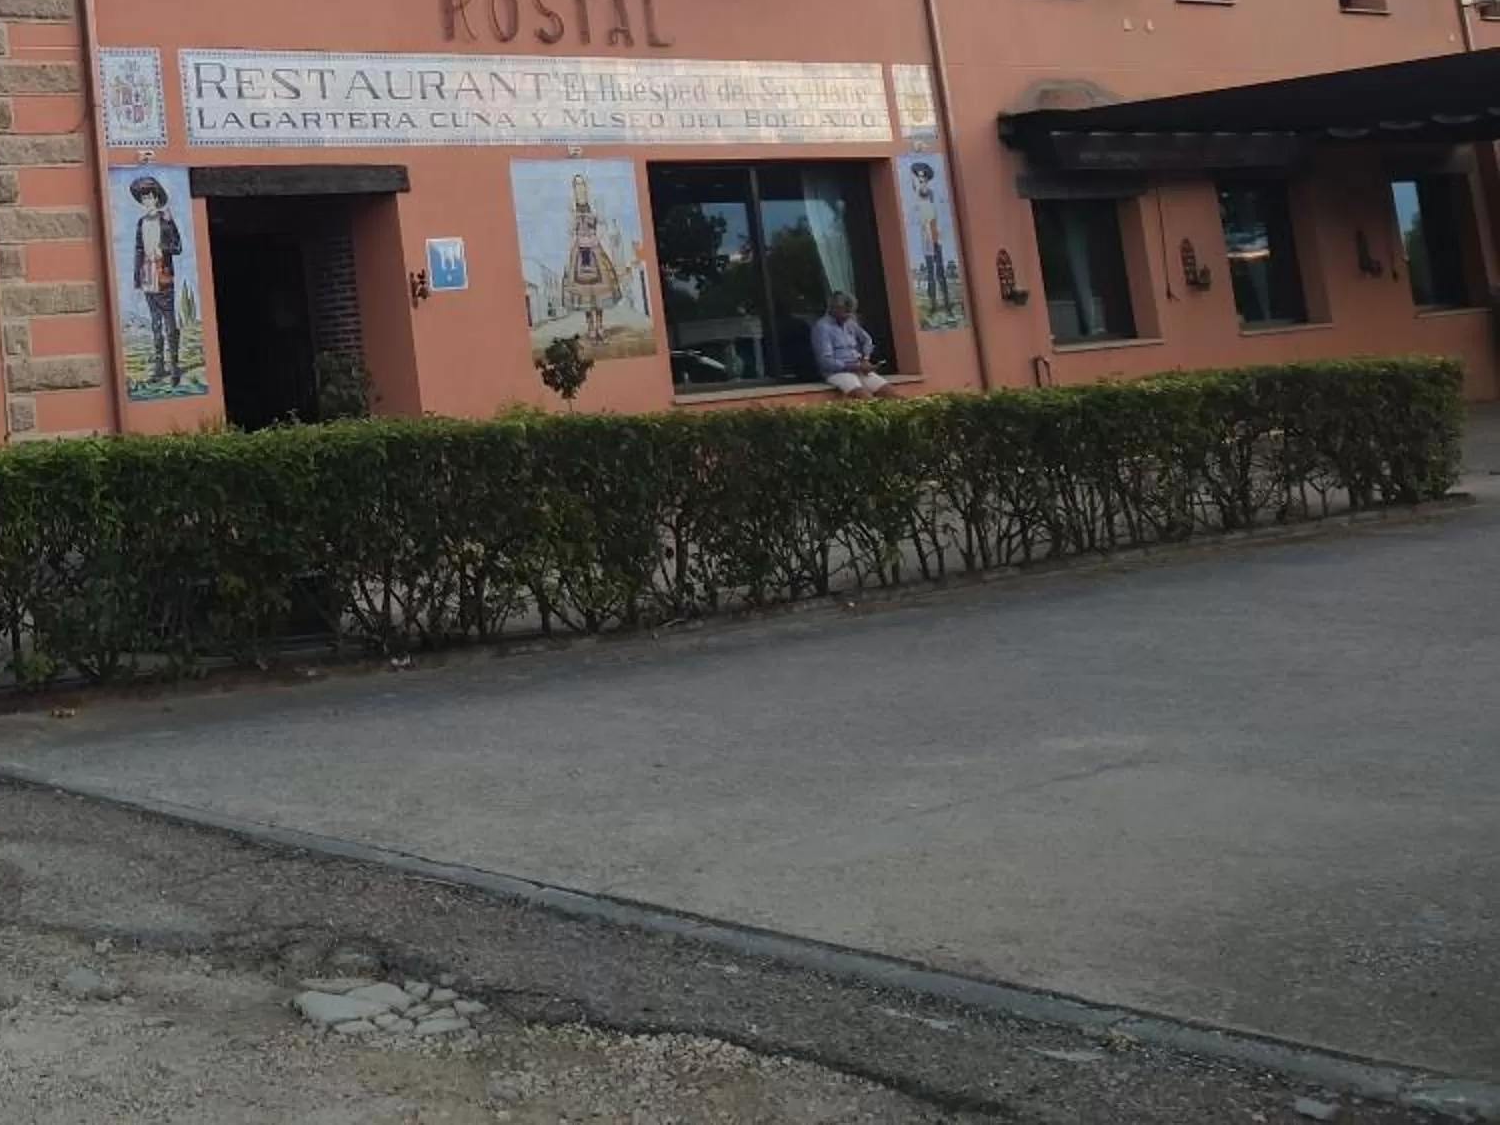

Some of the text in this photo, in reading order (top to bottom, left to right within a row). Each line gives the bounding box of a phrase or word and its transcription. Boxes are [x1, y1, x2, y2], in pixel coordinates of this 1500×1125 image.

[193, 61, 550, 101] RESTAURANT
[197, 106, 416, 129] LAGARTERA
[429, 110, 517, 129] CUNA
[531, 111, 549, 129] Y
[561, 107, 665, 129] MUSEO
